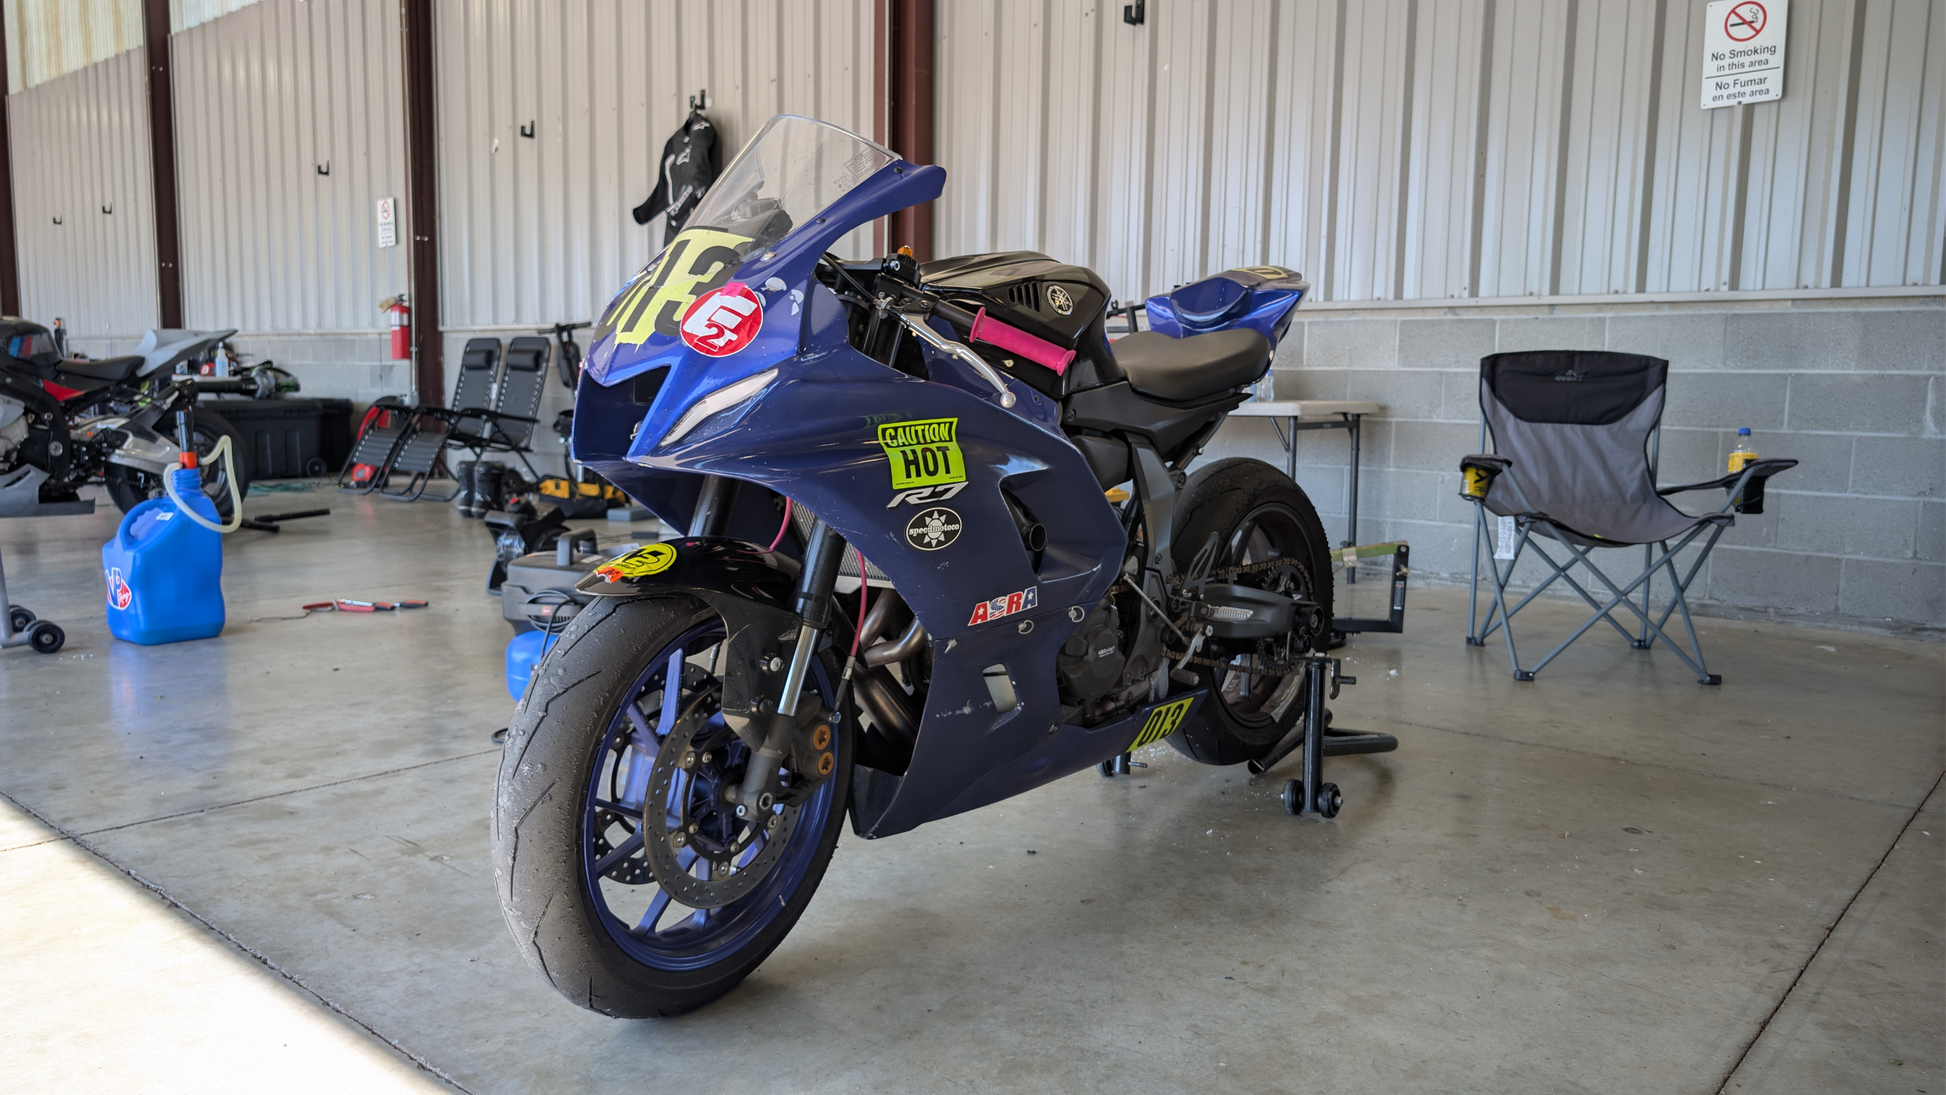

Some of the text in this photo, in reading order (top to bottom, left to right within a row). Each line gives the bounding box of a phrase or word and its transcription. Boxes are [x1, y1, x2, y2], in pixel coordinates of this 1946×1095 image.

[1711, 45, 1777, 62] No Smoking
[1716, 58, 1769, 72] in this area
[1712, 88, 1770, 102] en este area
[1715, 77, 1768, 91] No Fumar
[885, 423, 950, 447] CAUTION
[900, 446, 951, 479] HOT
[886, 481, 969, 508] R7
[967, 586, 1038, 627] ASRA
[1136, 702, 1185, 747] 013
